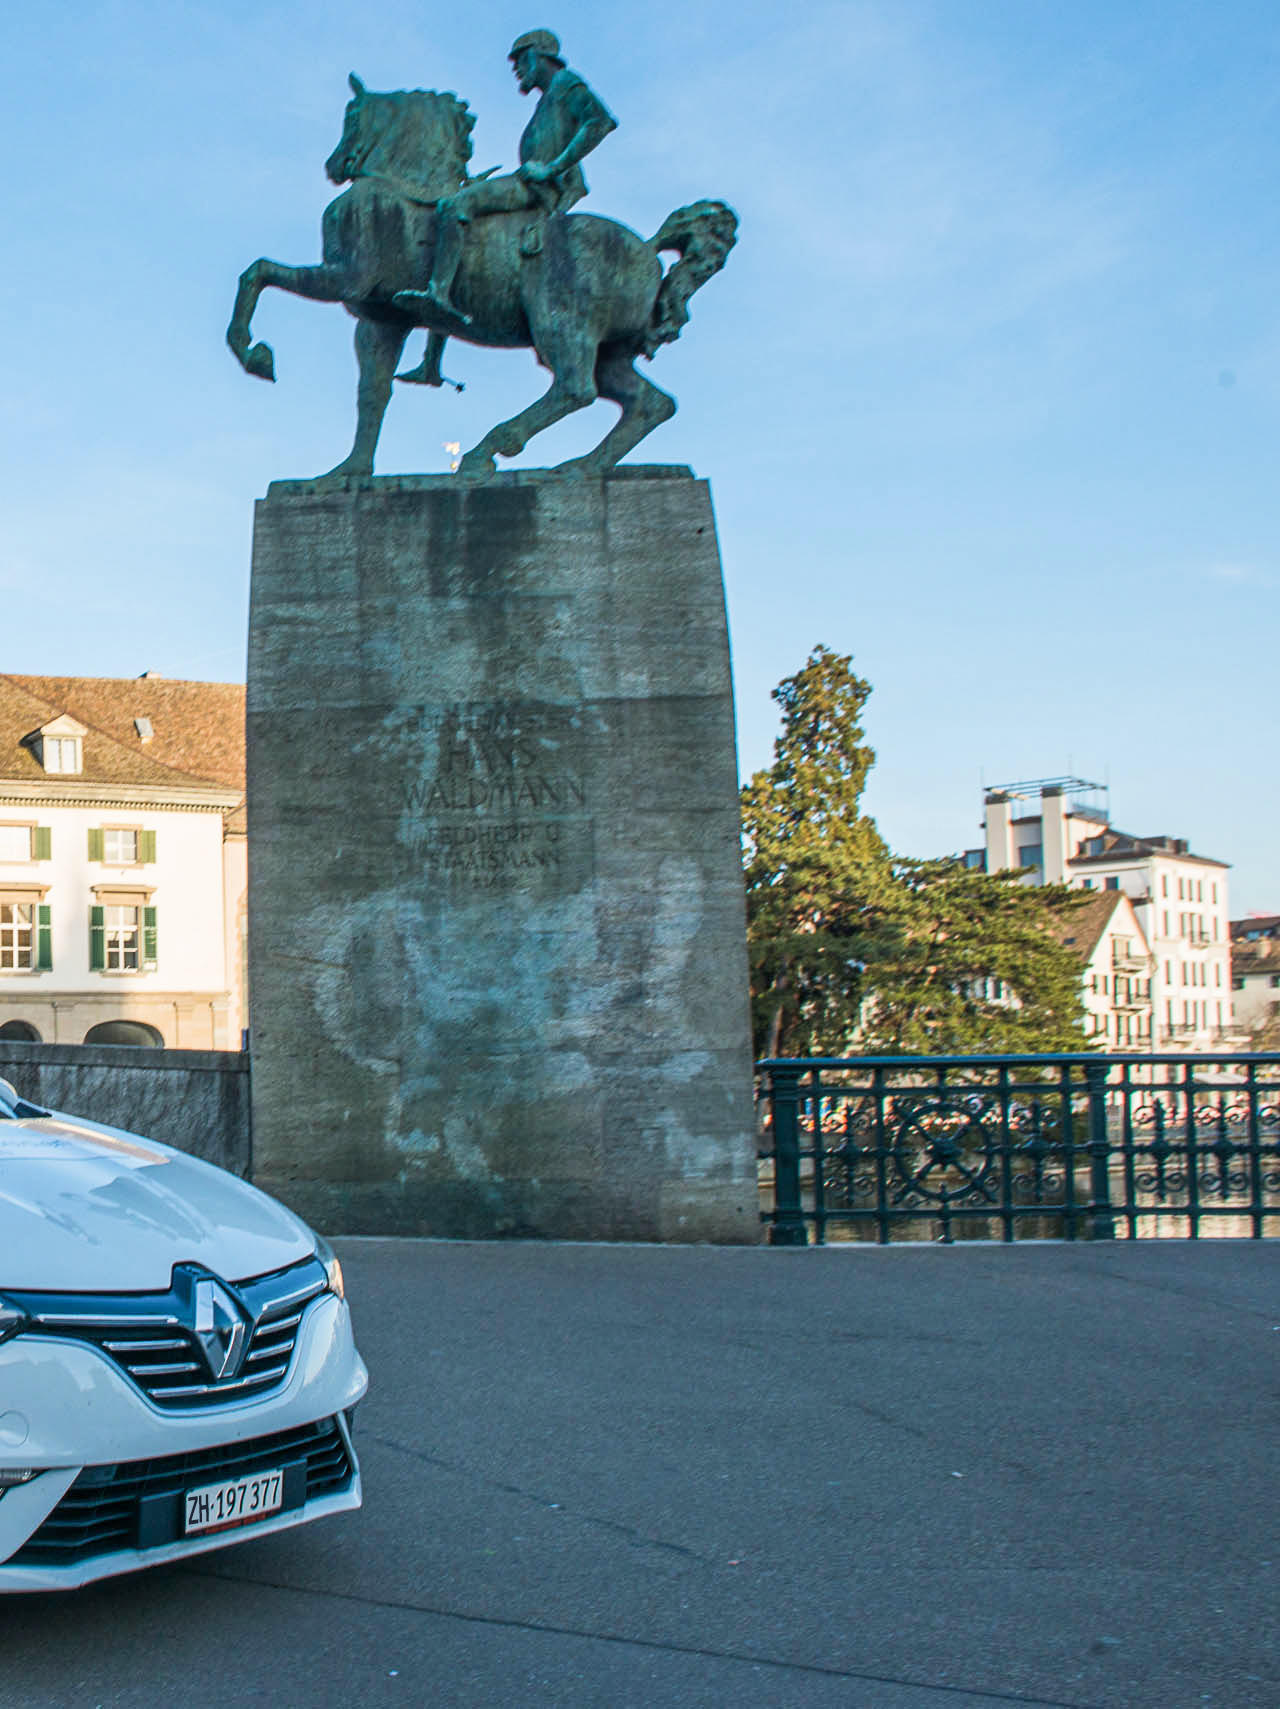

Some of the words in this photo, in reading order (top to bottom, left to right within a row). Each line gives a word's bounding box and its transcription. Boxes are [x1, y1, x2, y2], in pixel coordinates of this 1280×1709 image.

[447, 737, 537, 773] HANS
[401, 774, 588, 810] WALDMANN
[429, 848, 561, 870] STAATSMANN
